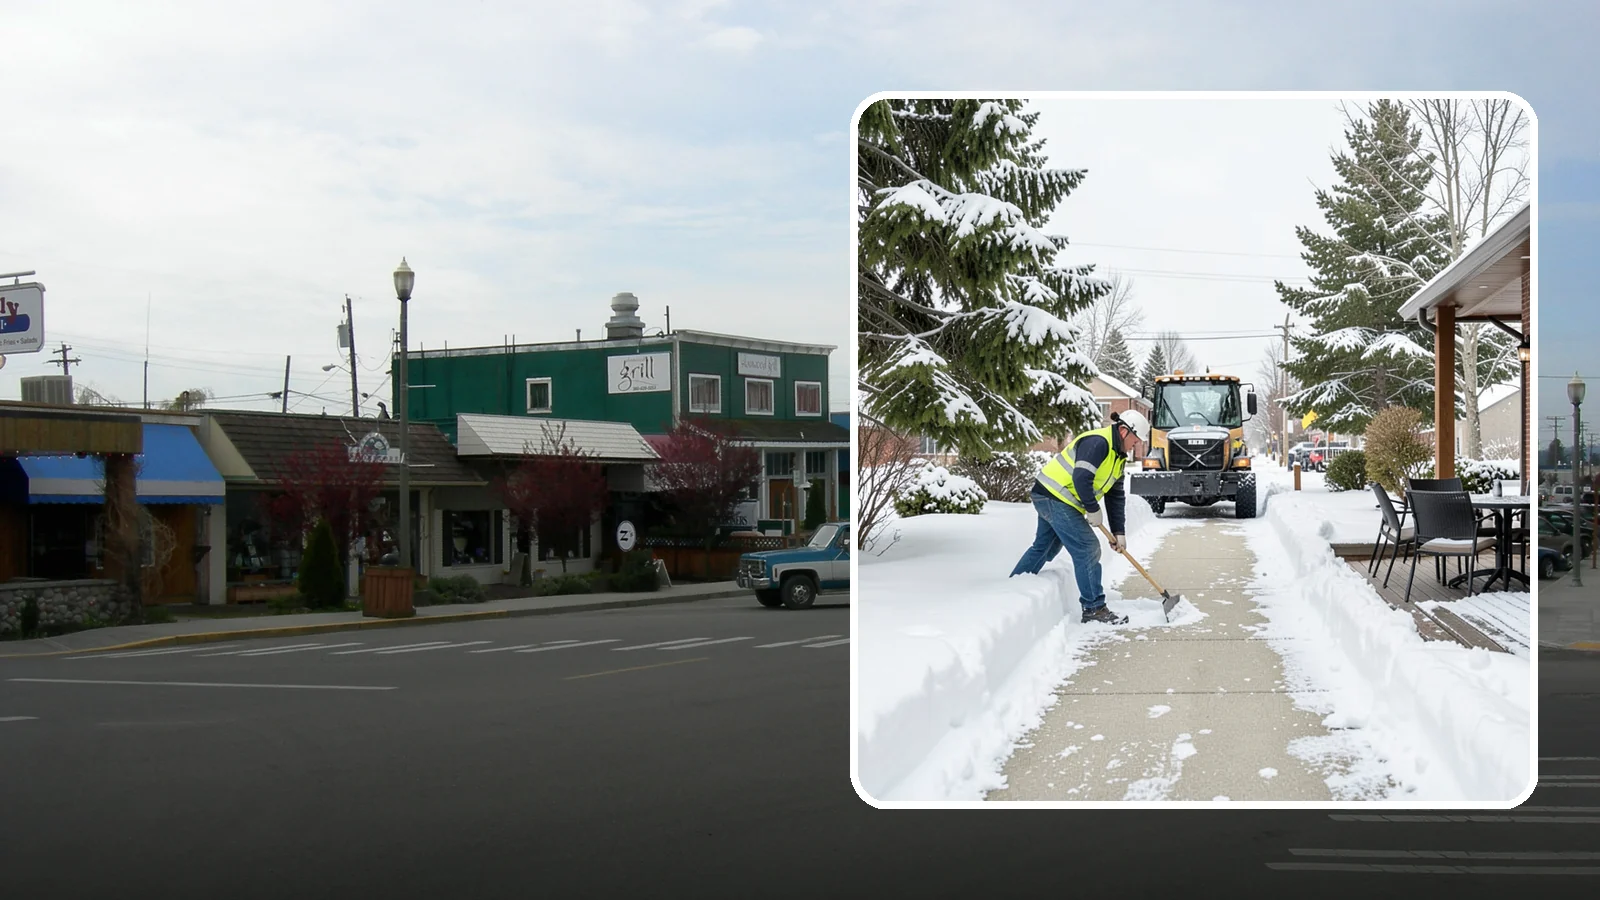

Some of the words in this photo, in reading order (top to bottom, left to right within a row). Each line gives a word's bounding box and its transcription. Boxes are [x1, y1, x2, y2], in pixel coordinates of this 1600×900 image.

[3, 338, 16, 346] Fries
[20, 337, 38, 345] Salads
[617, 355, 655, 391] grill
